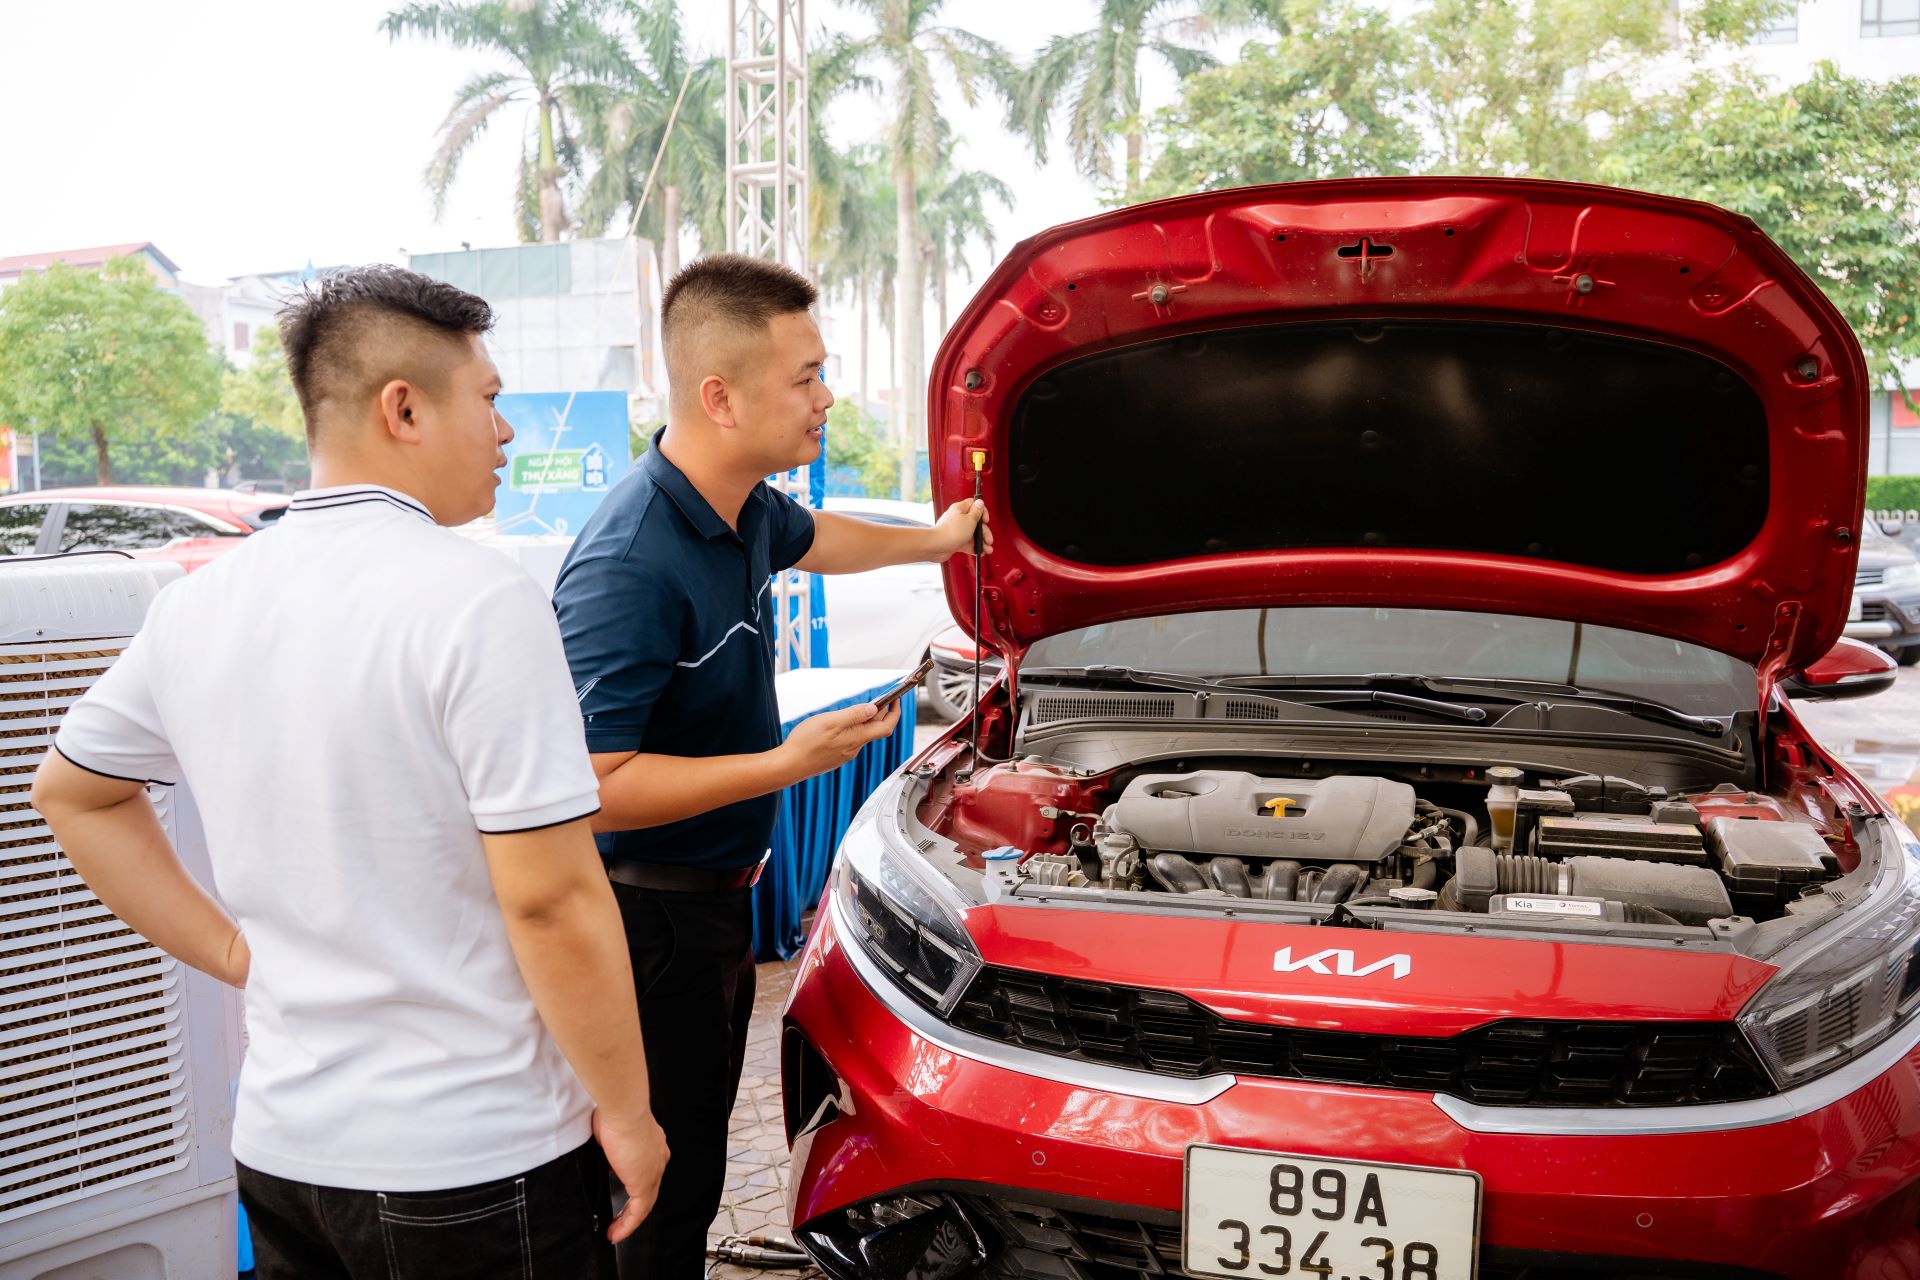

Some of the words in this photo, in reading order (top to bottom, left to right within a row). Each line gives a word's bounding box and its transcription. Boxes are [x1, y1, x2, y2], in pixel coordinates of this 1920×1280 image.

[1514, 900, 1533, 909] Kia
[1273, 946, 1411, 980] KIA
[1269, 1164, 1387, 1227] 89A
[1217, 1219, 1438, 1280] 334.38
